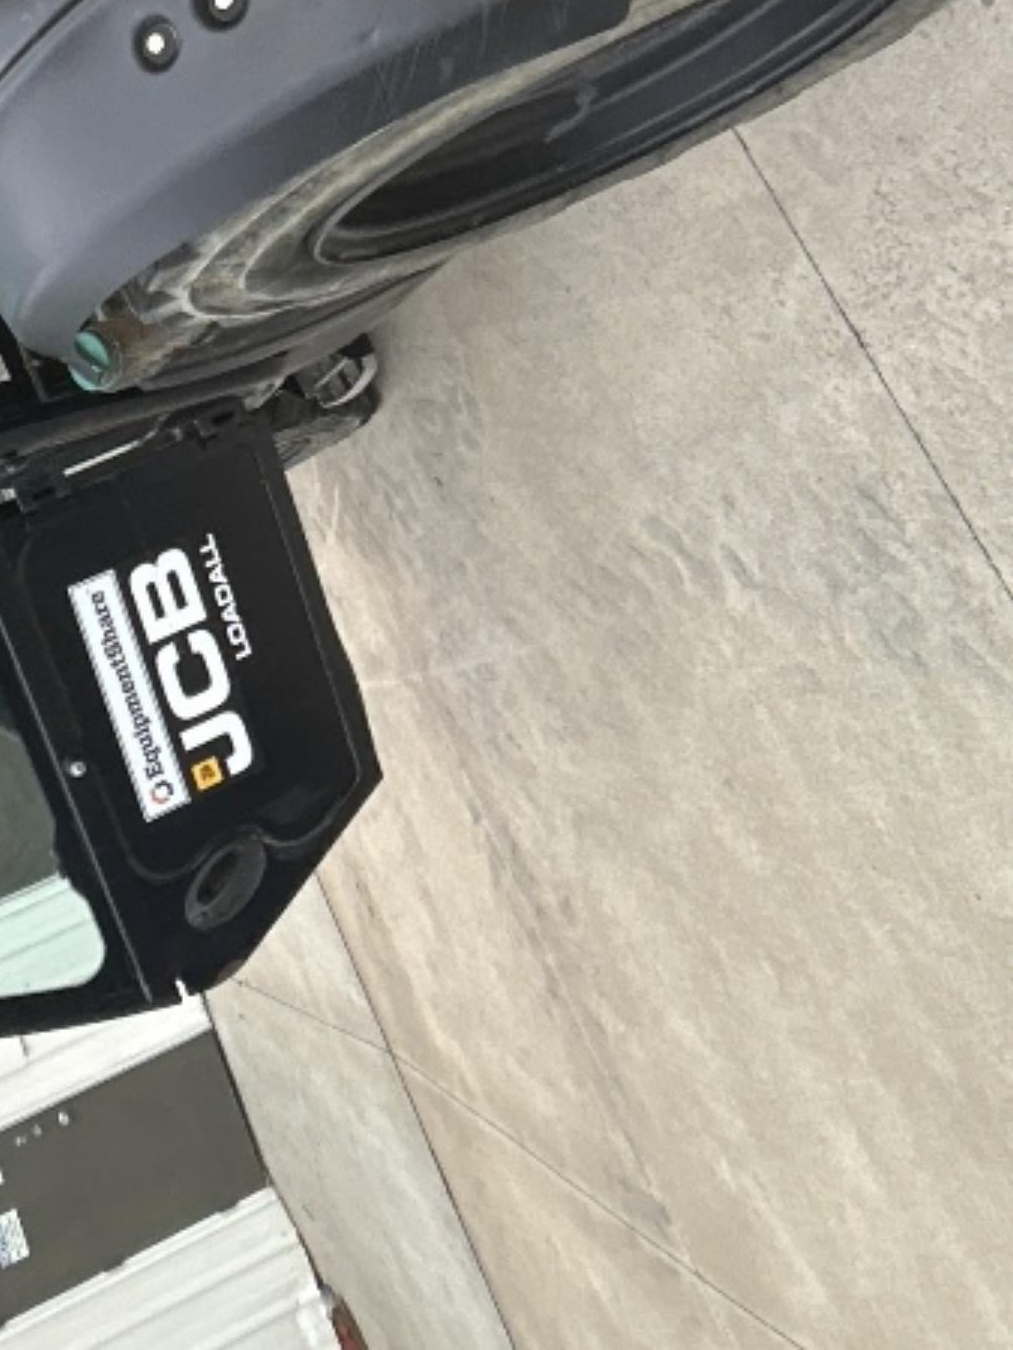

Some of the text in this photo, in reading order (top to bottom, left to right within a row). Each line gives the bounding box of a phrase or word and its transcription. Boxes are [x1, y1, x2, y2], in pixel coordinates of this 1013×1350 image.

[91, 589, 165, 780] EquipmentShare
[129, 547, 255, 777] JCB
[199, 532, 253, 661] LOADALL
